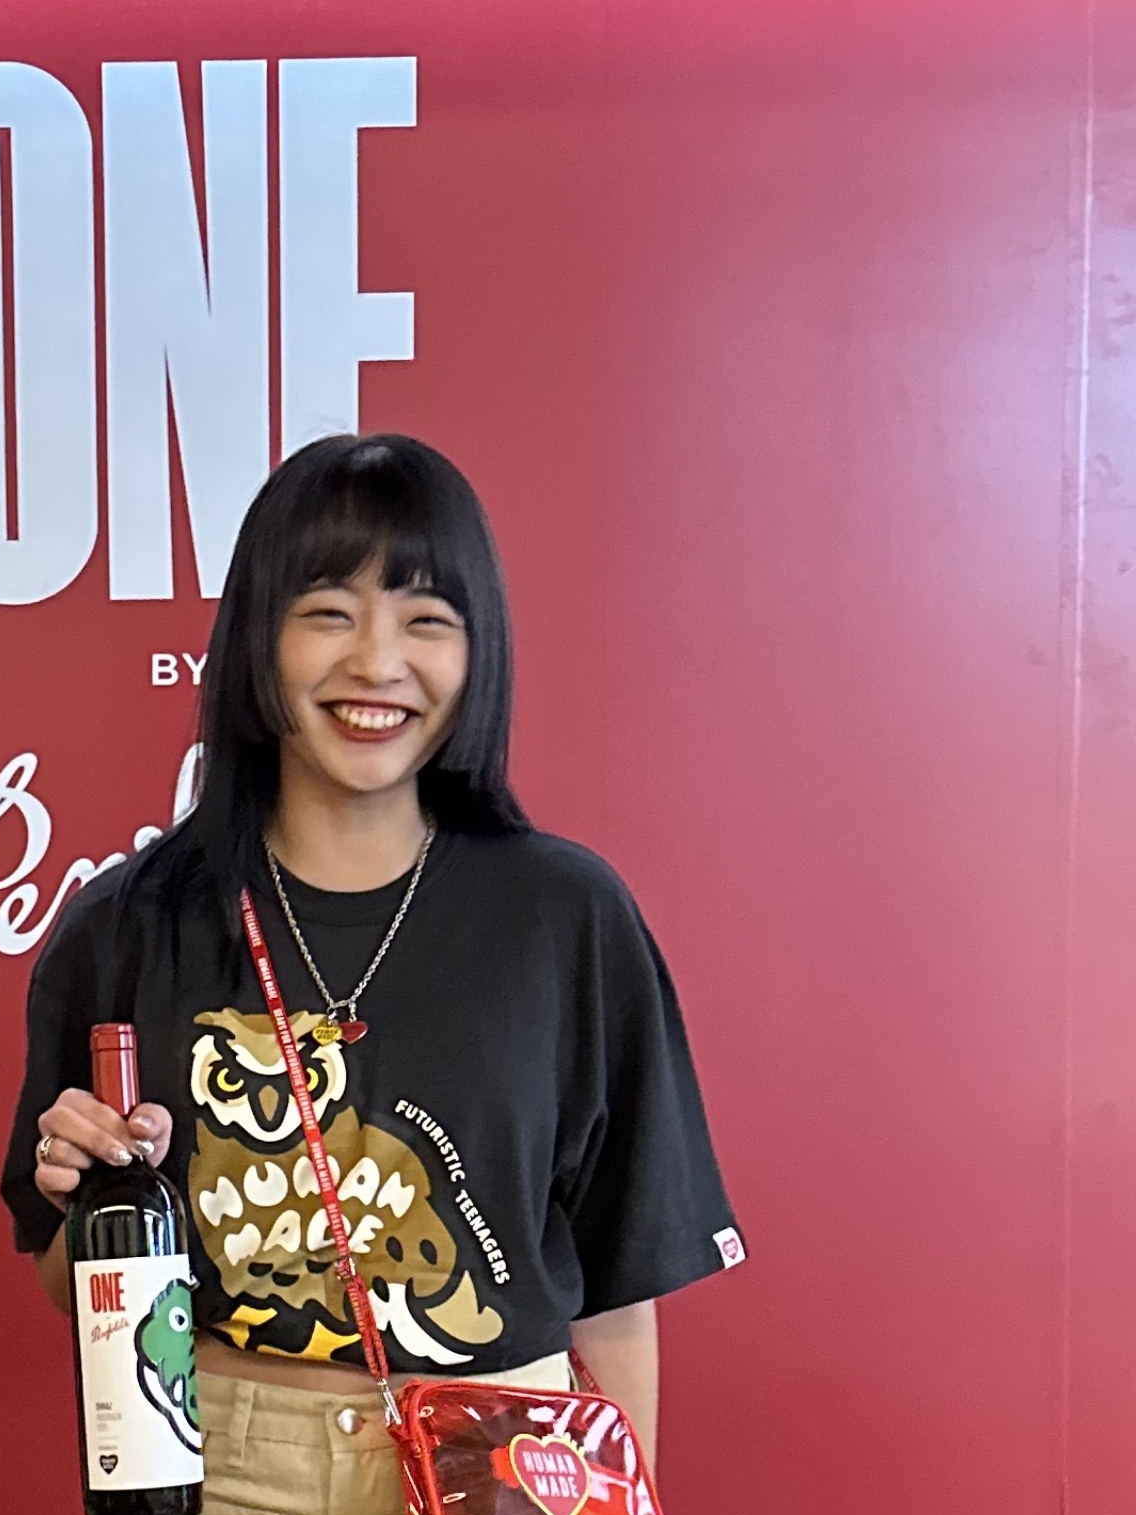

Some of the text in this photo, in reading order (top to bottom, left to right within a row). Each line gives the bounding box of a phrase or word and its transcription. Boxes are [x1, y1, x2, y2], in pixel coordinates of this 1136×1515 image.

[151, 653, 208, 686] BY
[198, 1155, 416, 1228] HUMAN
[394, 1099, 511, 1286] FUTURISTIC TEENAGERS
[223, 1208, 385, 1268] MADE
[90, 1271, 126, 1314] ONE
[523, 1450, 577, 1476] HUMAN
[534, 1474, 580, 1499] MADE
